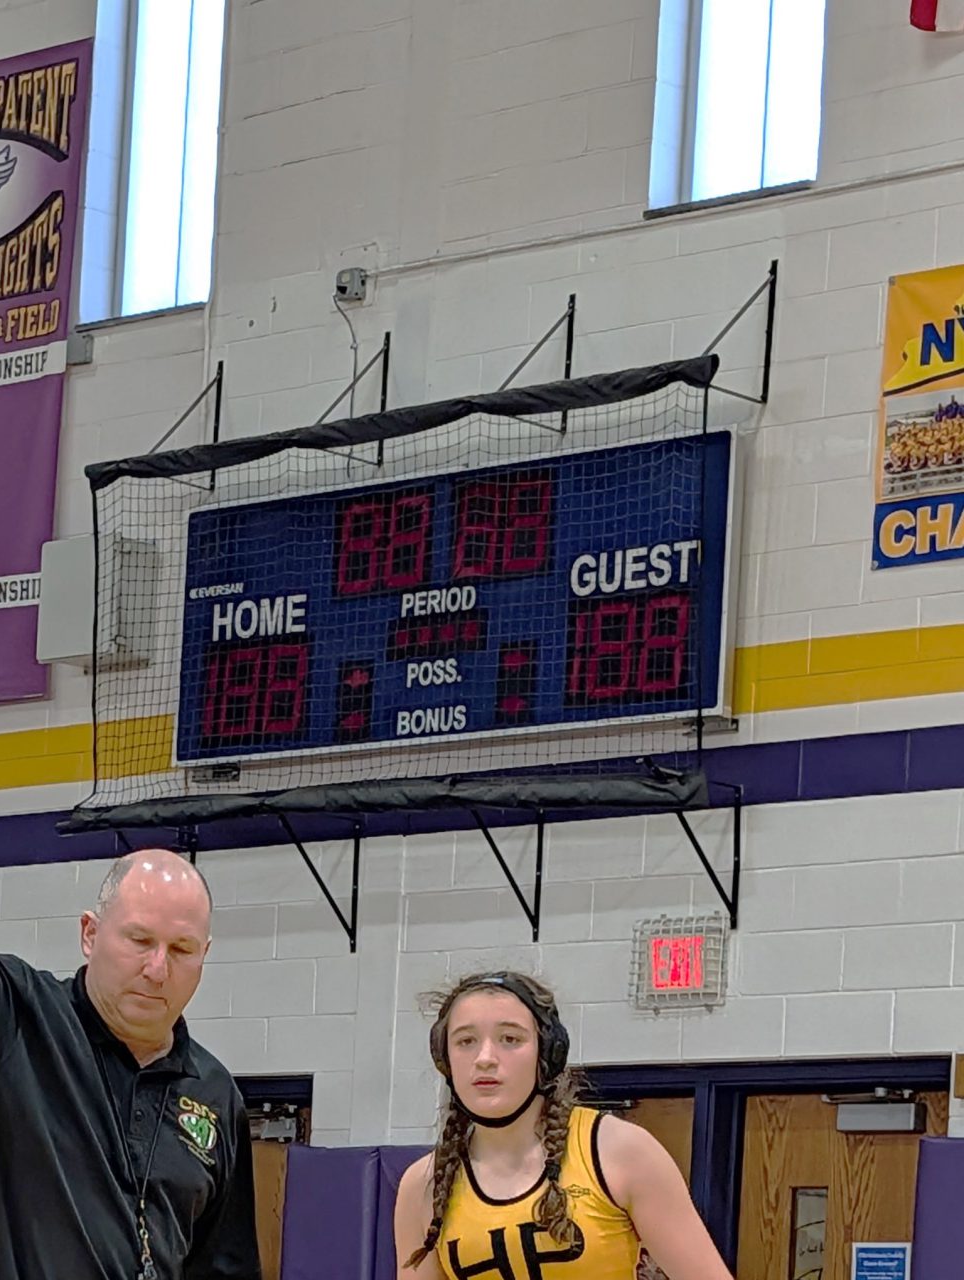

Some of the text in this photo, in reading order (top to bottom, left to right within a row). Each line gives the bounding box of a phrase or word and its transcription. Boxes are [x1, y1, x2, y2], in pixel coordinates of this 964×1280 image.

[920, 317, 964, 366] N
[570, 540, 697, 597] GUEST
[212, 594, 307, 641] HOME
[401, 585, 476, 617] PERIOD
[406, 657, 462, 688] POSS.
[396, 704, 467, 736] BONUS
